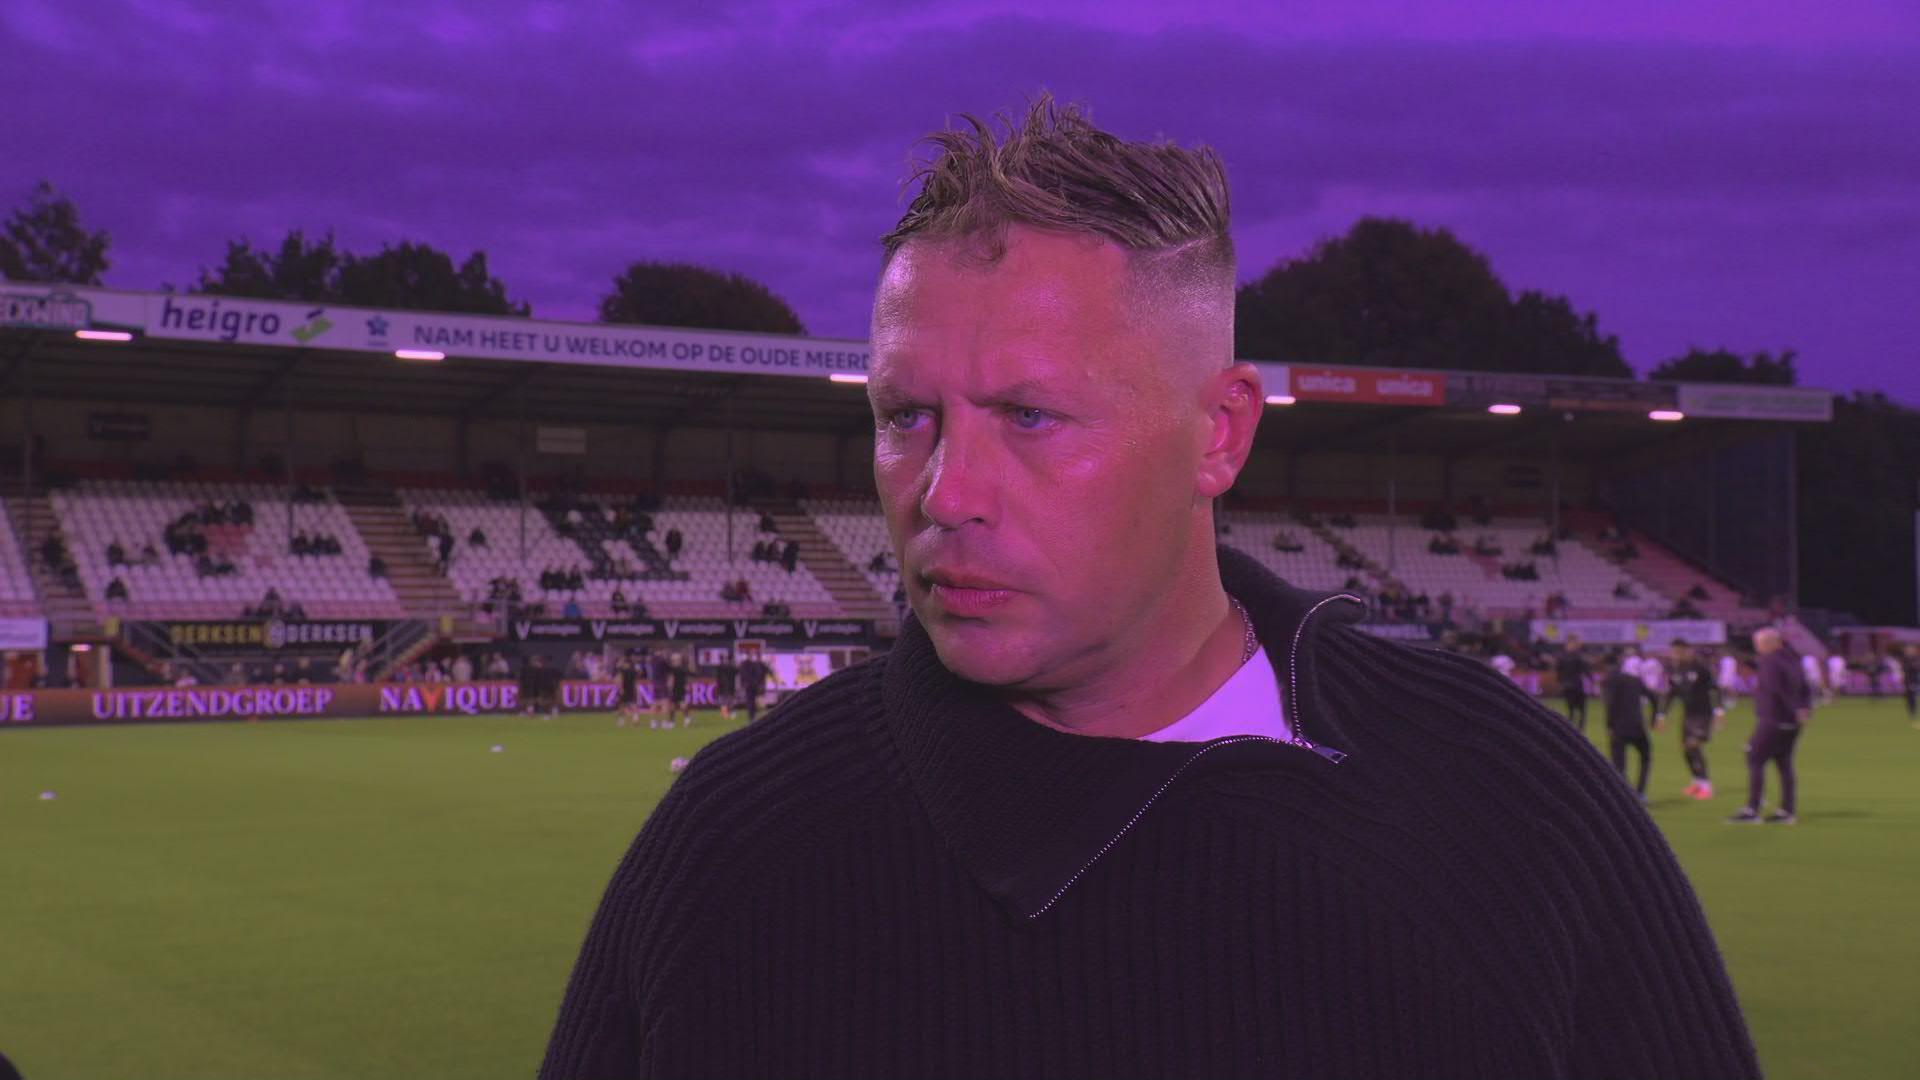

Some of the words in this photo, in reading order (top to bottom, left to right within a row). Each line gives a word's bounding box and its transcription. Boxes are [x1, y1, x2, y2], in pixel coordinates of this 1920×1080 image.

[160, 298, 281, 342] heigro
[413, 325, 474, 347] NAM
[480, 330, 537, 351] HEET
[544, 334, 561, 353] U
[565, 335, 667, 359] WELKOM
[671, 342, 704, 361] OP
[708, 345, 736, 364] DE
[741, 347, 800, 367] OUDE
[92, 688, 333, 719] UITZENDGROEP
[380, 685, 519, 714] NAVIQUE
